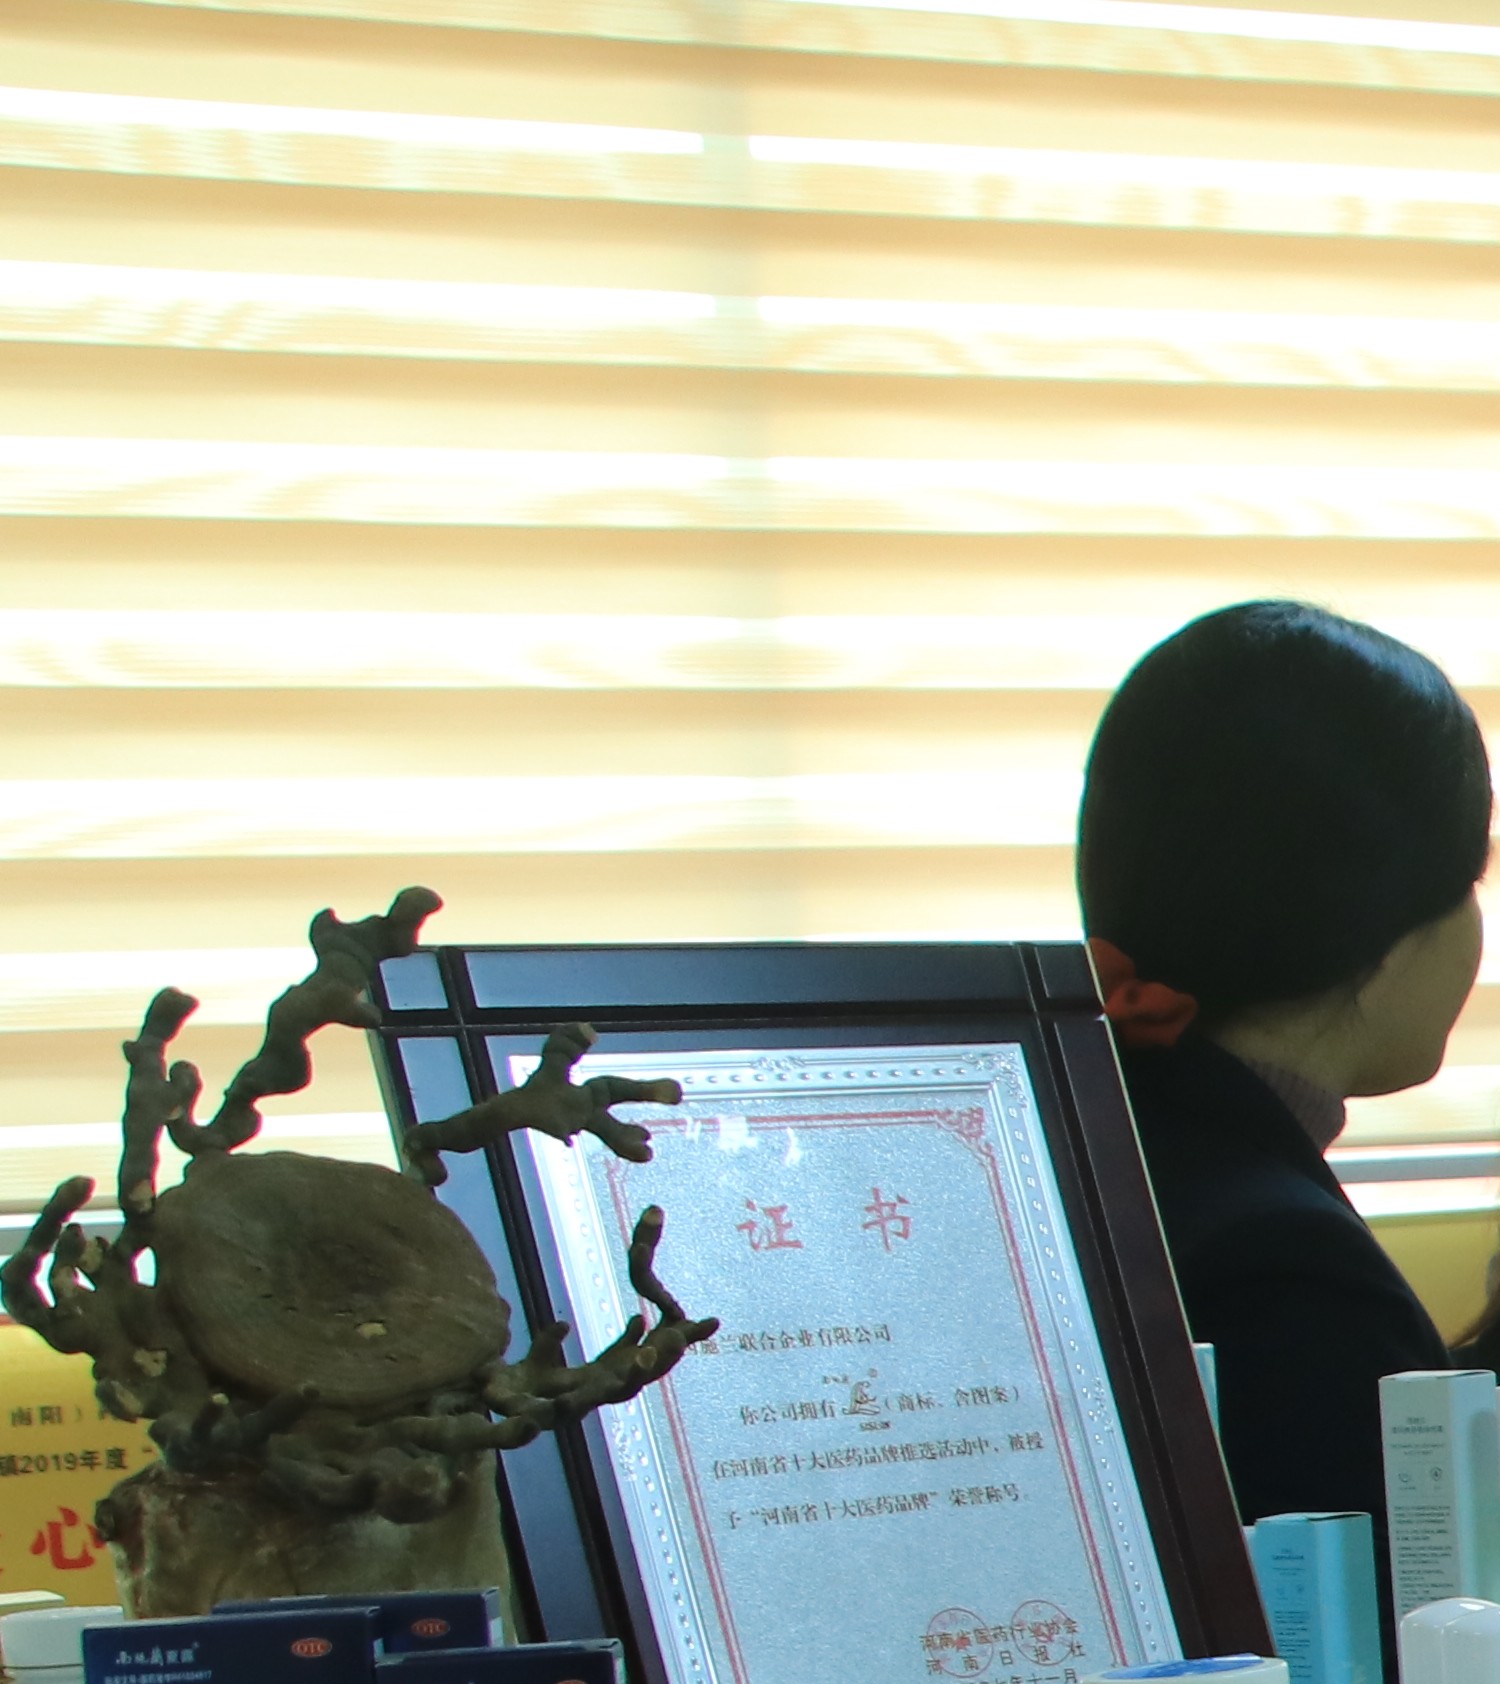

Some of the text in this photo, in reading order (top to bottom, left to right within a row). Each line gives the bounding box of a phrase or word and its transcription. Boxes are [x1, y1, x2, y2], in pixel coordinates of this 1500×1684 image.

[736, 1186, 915, 1253] 证书
[740, 1399, 837, 1427] 你公司拥有
[294, 1642, 328, 1655] OTC
